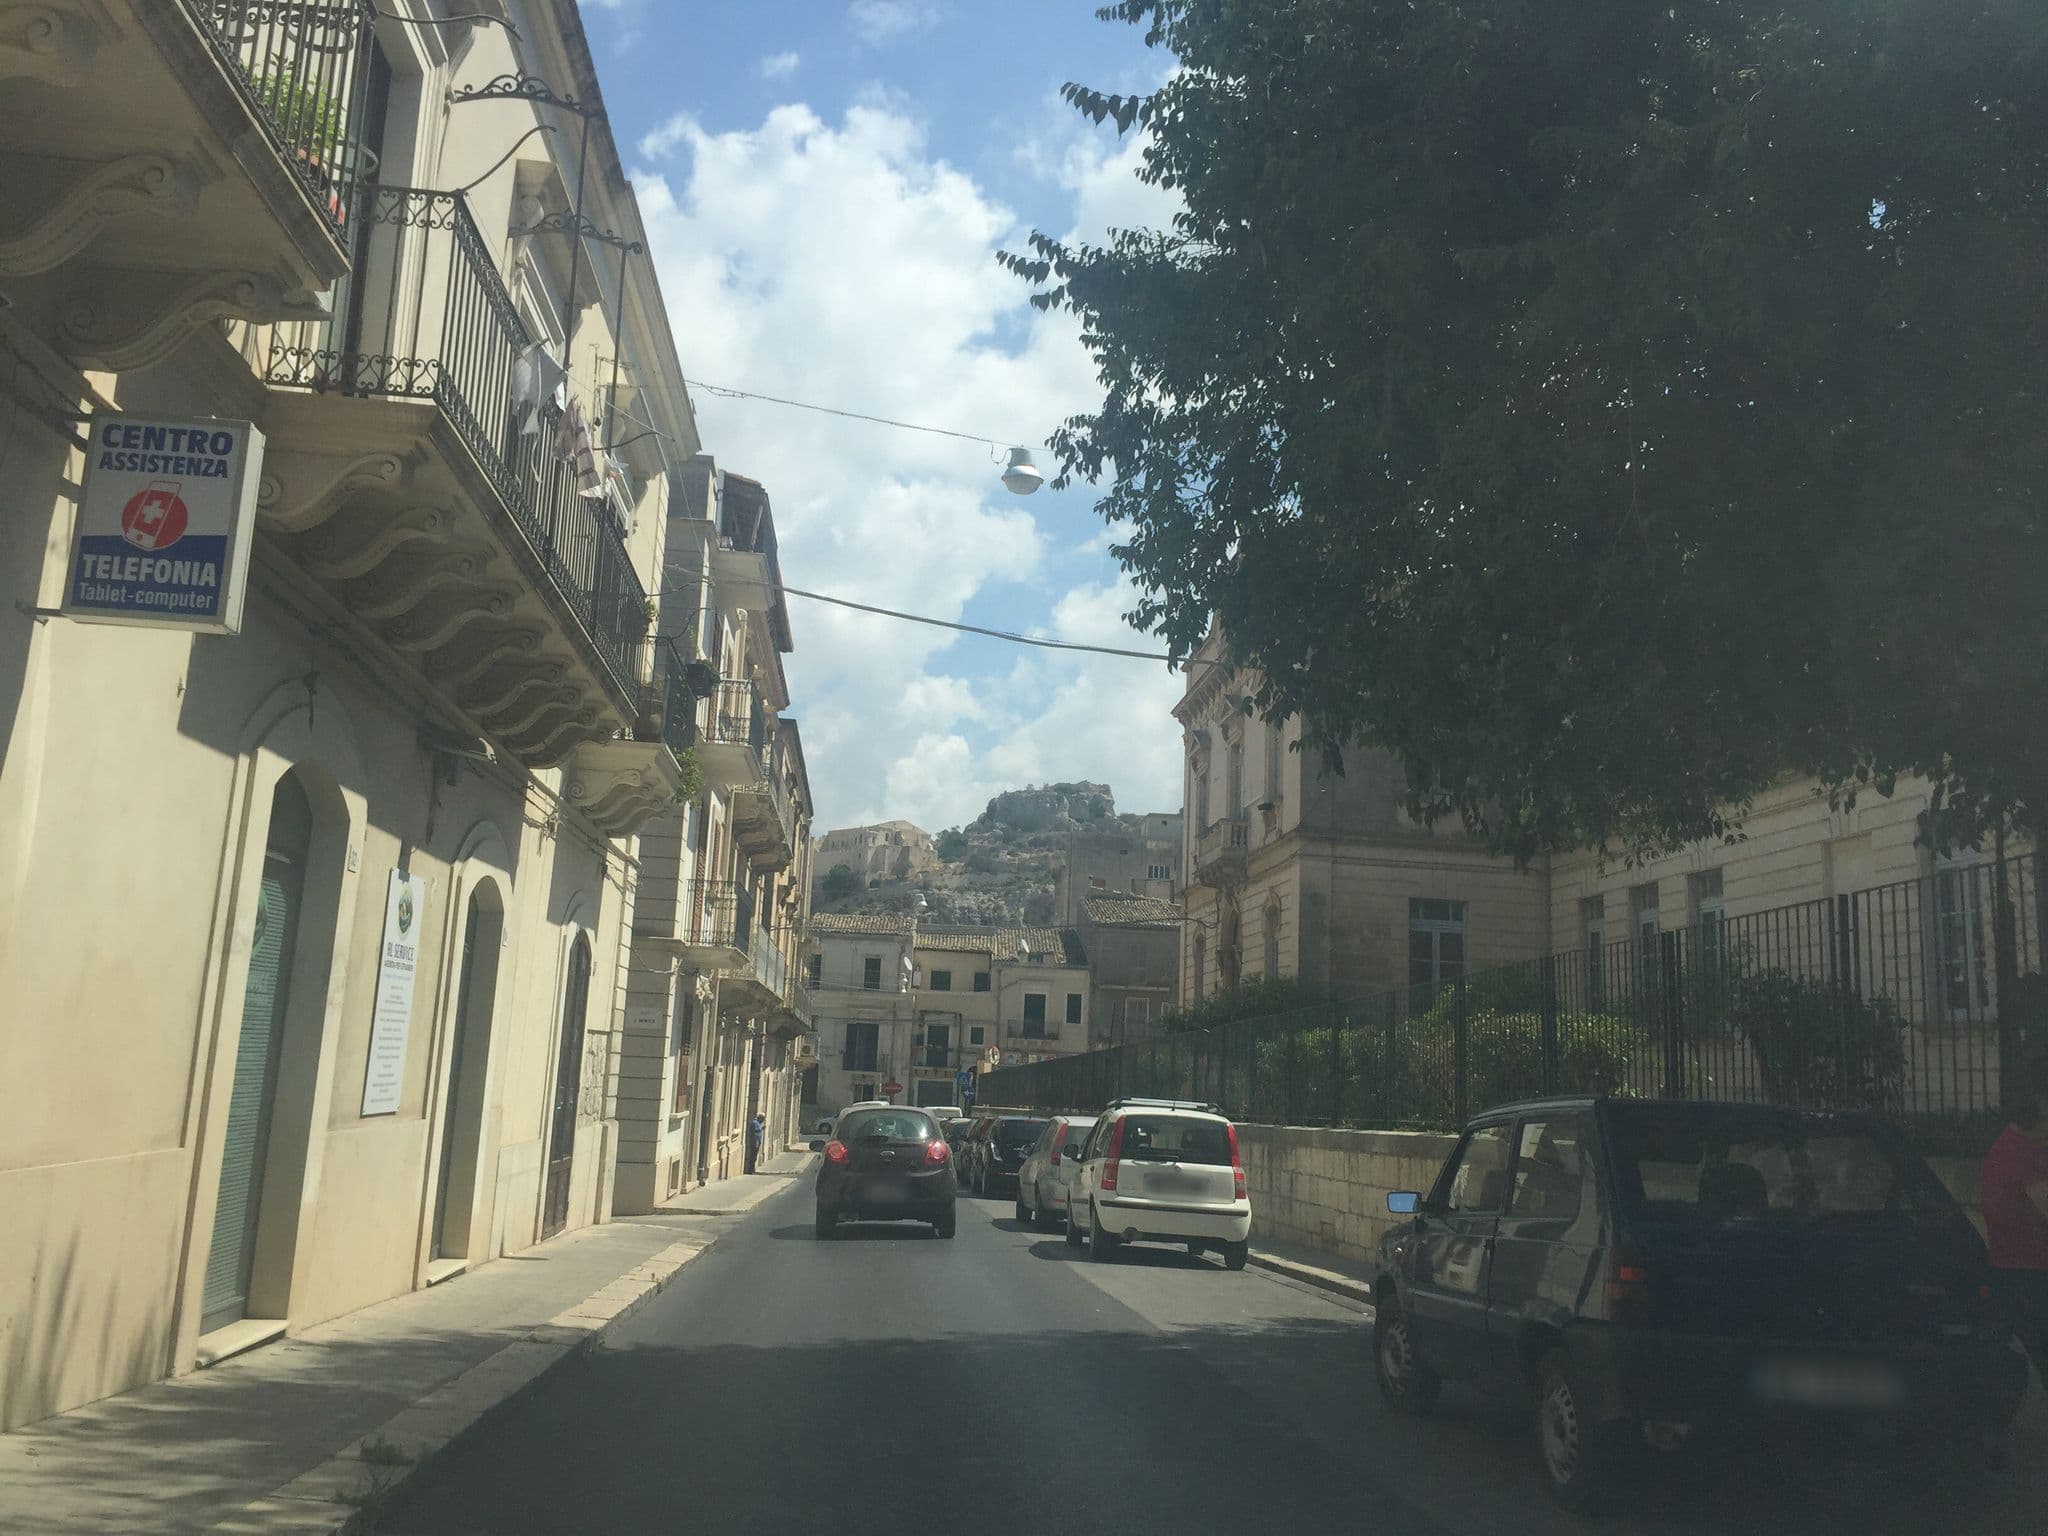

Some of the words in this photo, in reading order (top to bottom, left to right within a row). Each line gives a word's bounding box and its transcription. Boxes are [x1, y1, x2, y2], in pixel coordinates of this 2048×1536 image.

[102, 424, 233, 455] CENTRO
[99, 452, 228, 478] ASSISTENZA
[83, 554, 216, 587] TELEFONIA
